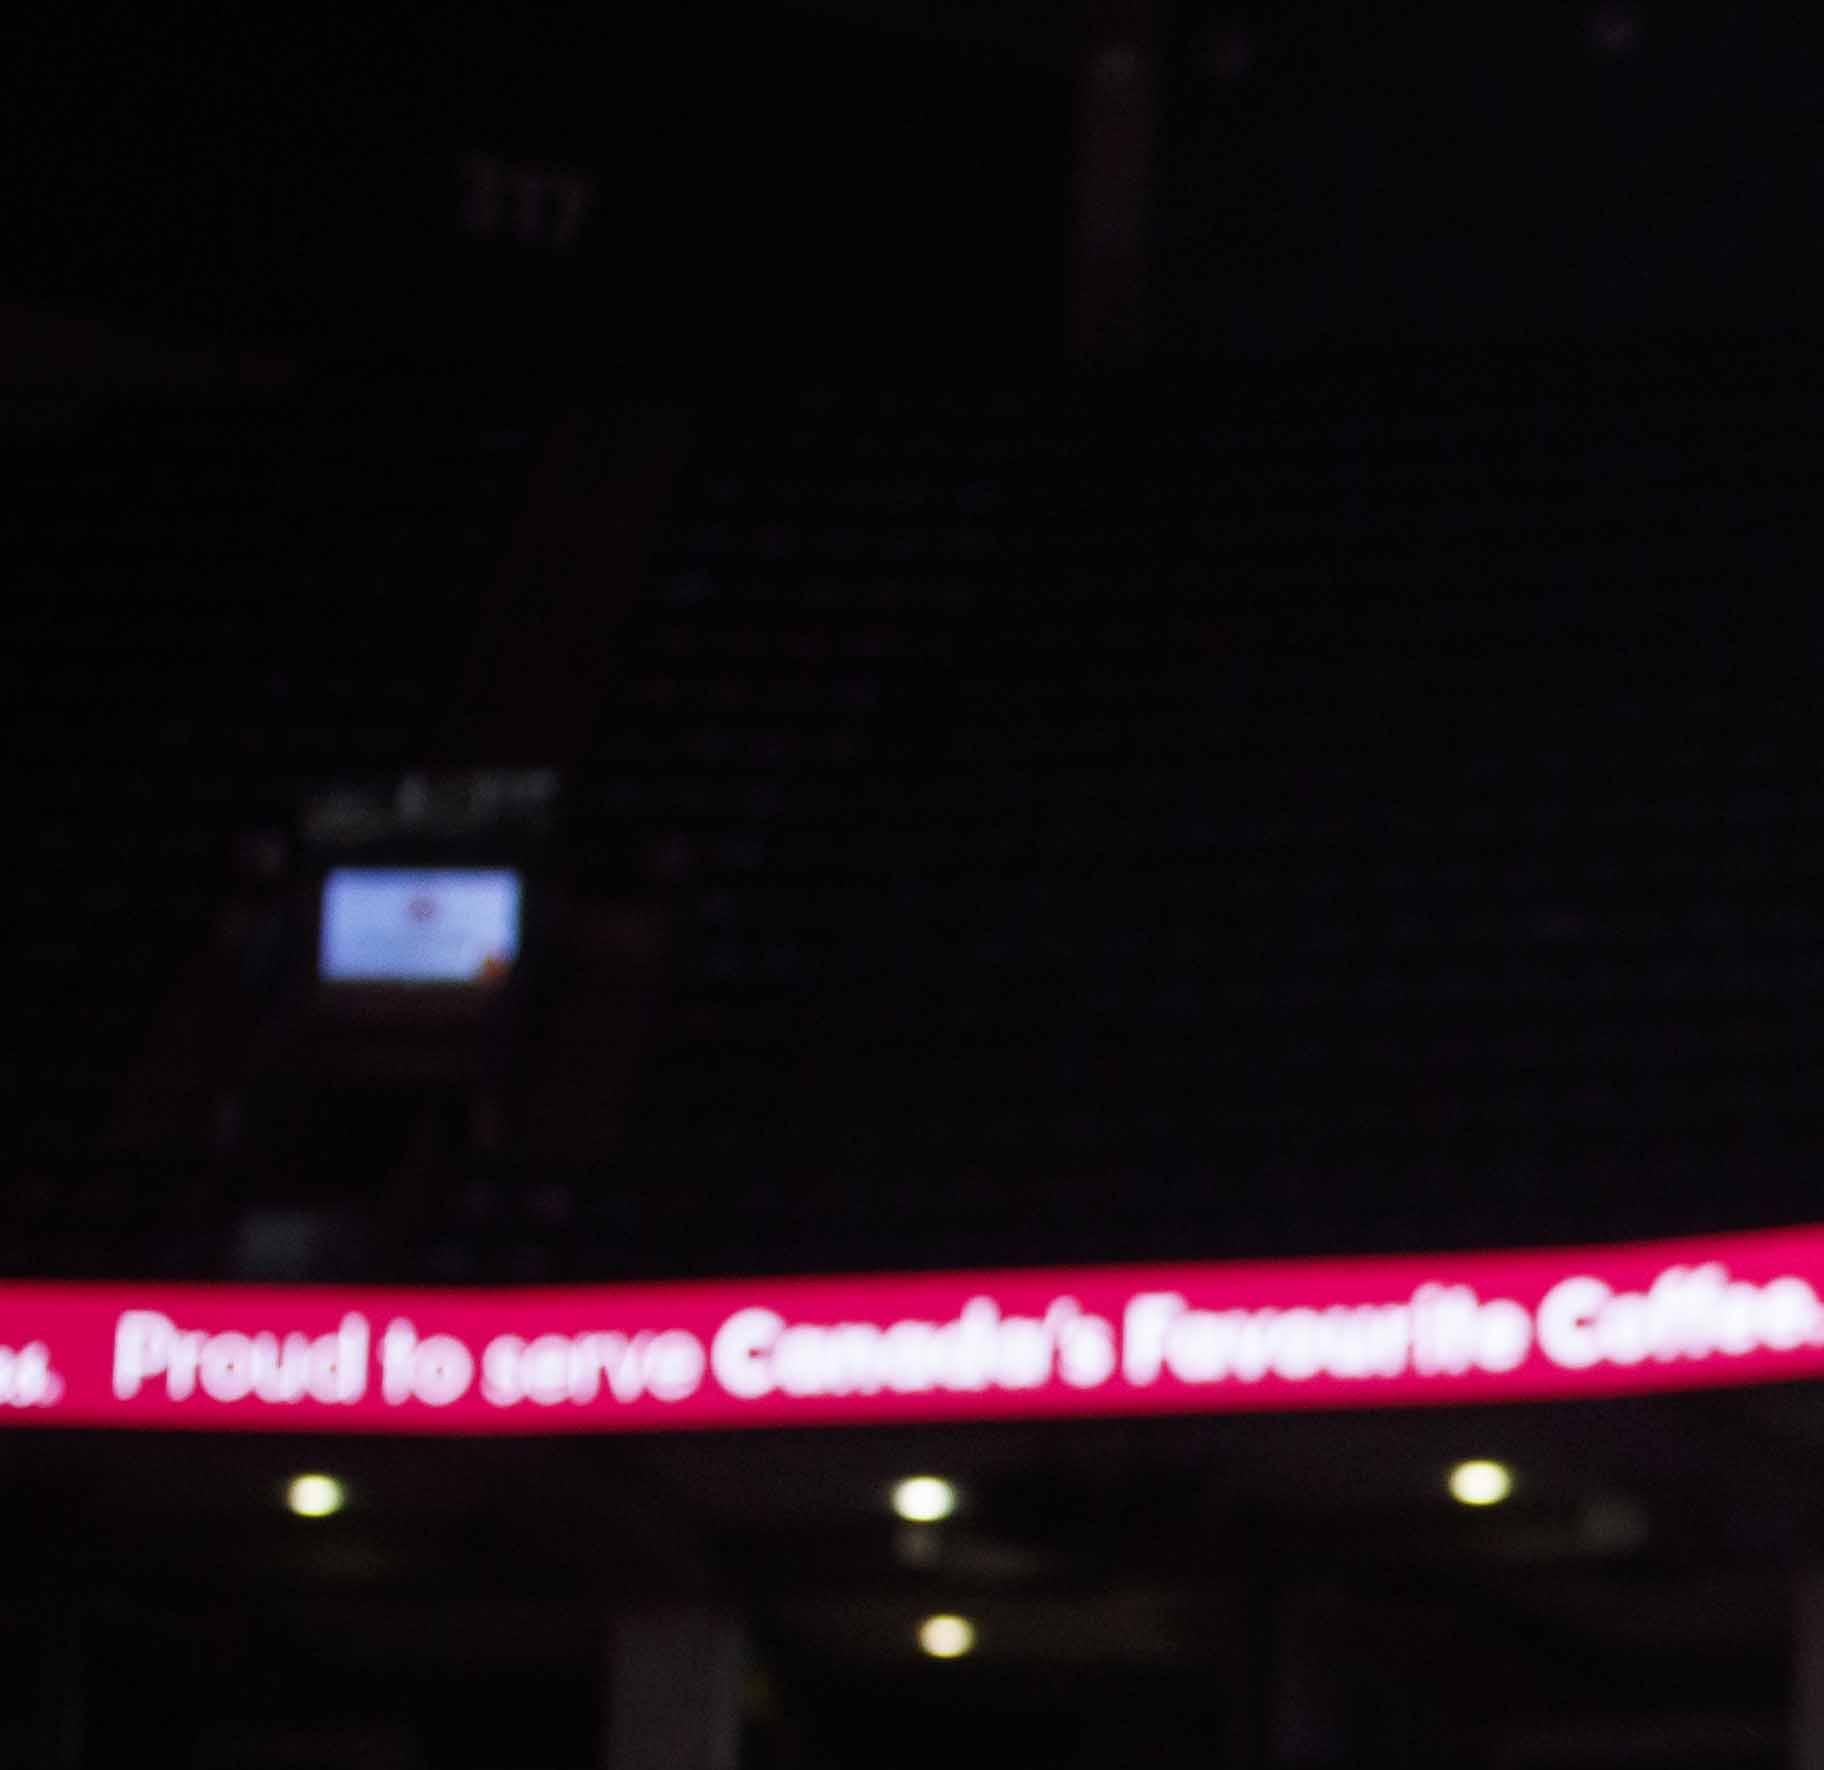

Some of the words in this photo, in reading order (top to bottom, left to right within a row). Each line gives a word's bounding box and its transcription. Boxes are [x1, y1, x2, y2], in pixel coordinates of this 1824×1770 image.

[112, 1310, 370, 1403] Proud
[381, 1318, 474, 1406] to
[481, 1330, 706, 1407] serve
[710, 1297, 1115, 1400] Canada's
[1121, 1283, 1532, 1387] Favourite
